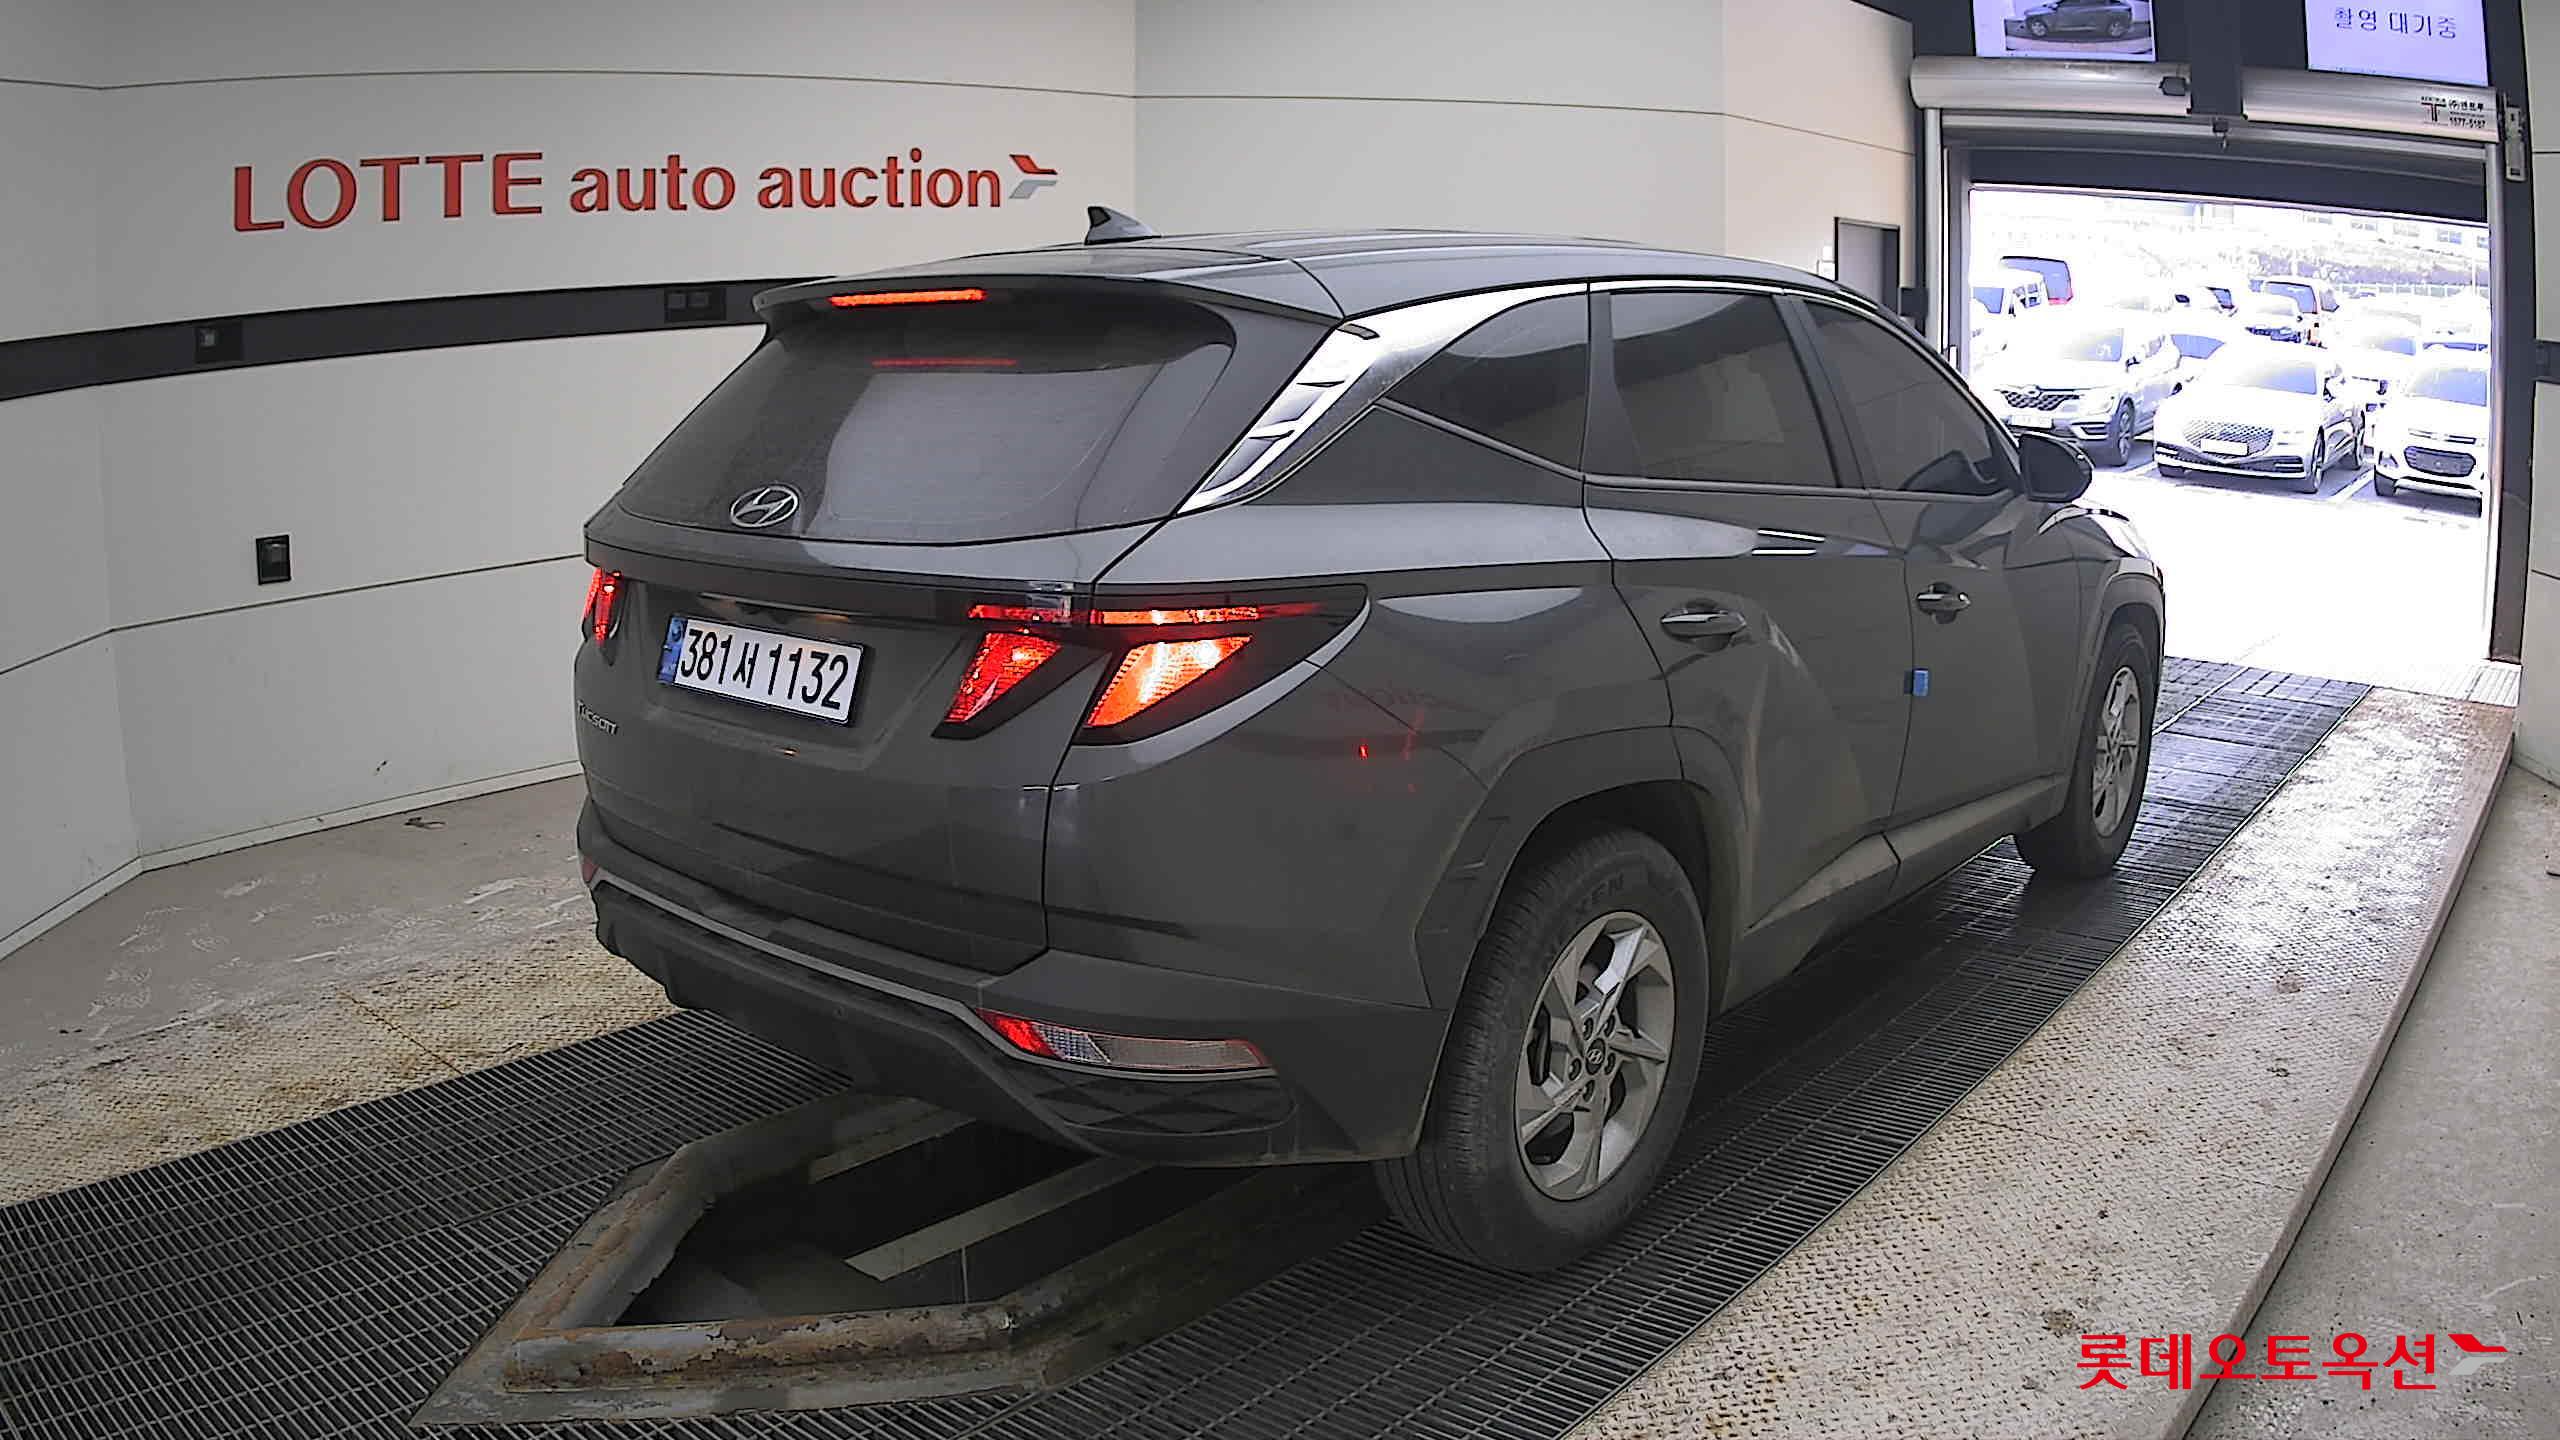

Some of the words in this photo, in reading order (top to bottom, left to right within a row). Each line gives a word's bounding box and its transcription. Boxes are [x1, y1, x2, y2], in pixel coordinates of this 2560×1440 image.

[2388, 12, 2457, 39] 대기중
[233, 152, 542, 233] LOTTE
[569, 155, 735, 212] auto
[757, 148, 1002, 208] auction
[767, 643, 849, 710] 1132
